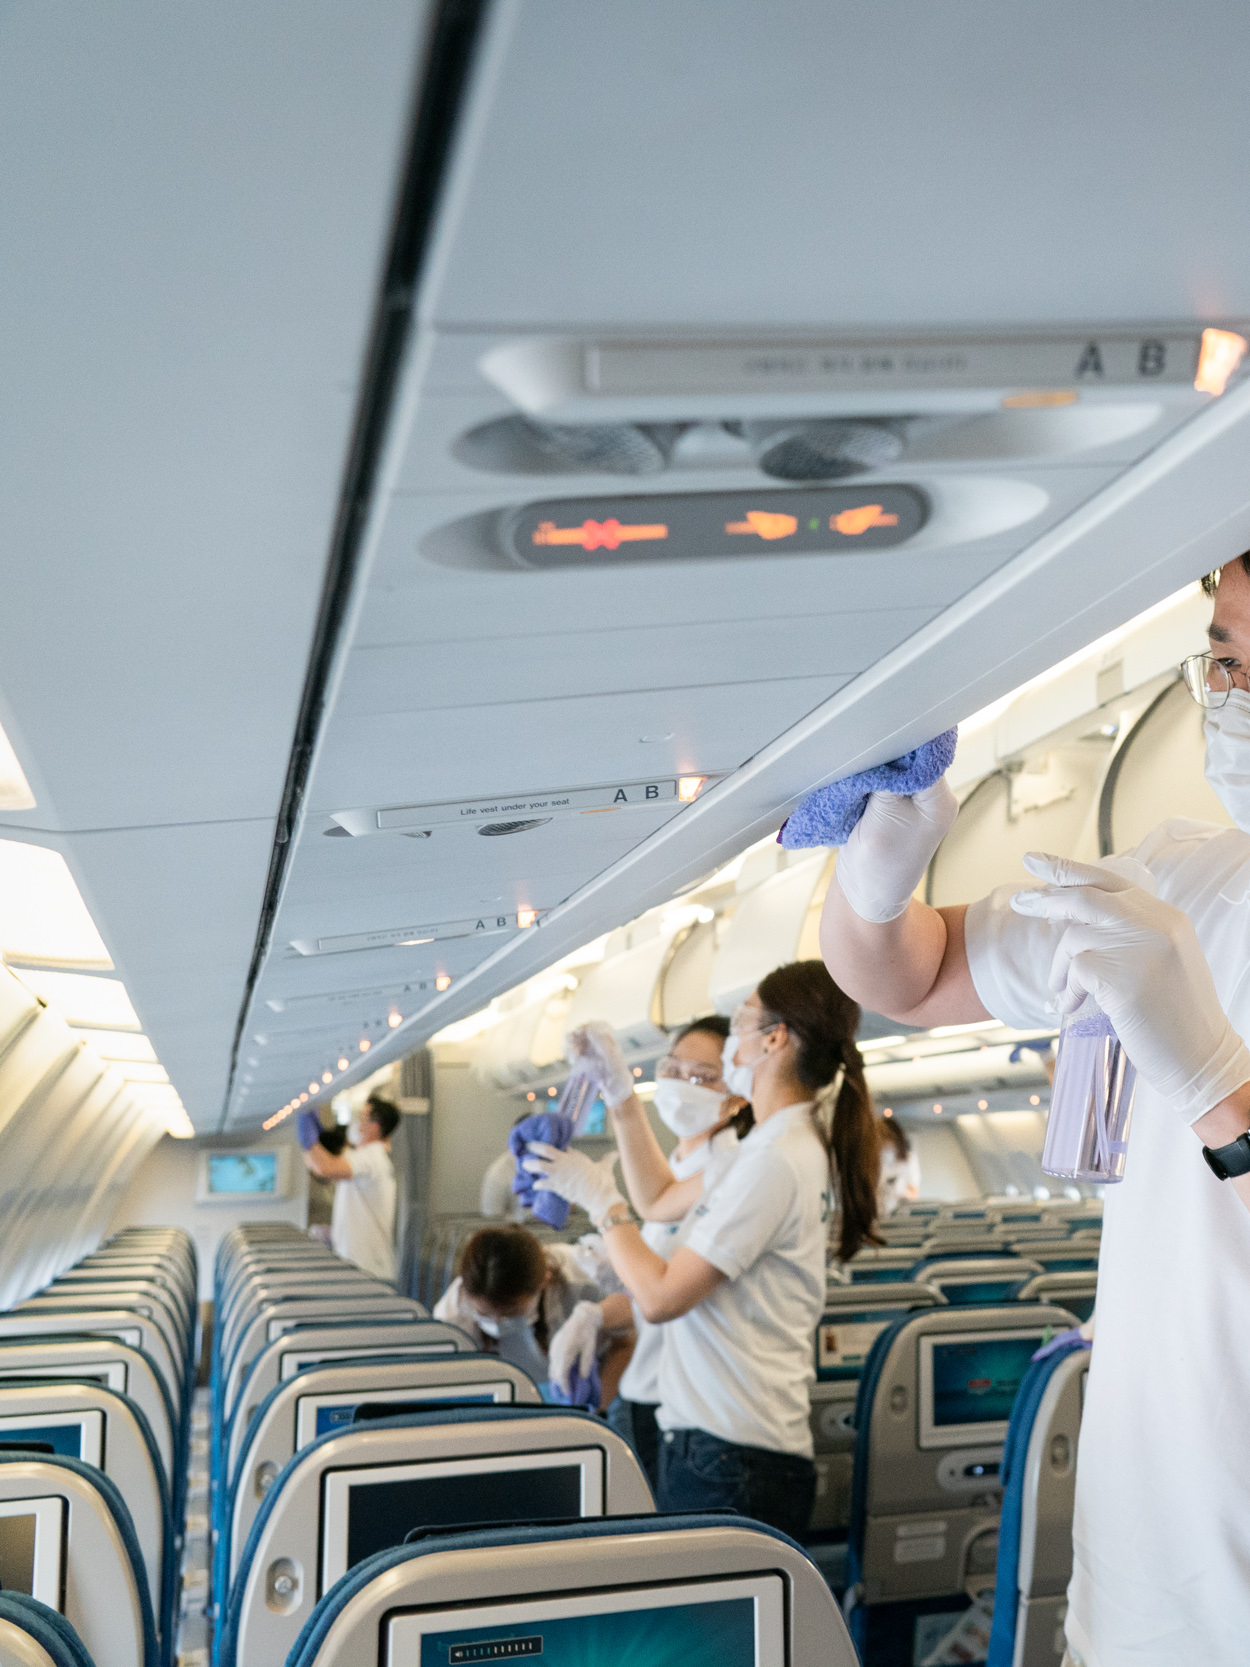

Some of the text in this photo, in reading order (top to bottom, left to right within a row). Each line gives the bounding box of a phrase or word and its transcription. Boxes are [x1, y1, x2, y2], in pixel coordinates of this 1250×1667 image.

[1074, 336, 1167, 380] A B
[613, 785, 659, 803] A B
[460, 798, 570, 816] Life vest under your seat
[475, 917, 507, 930] A B
